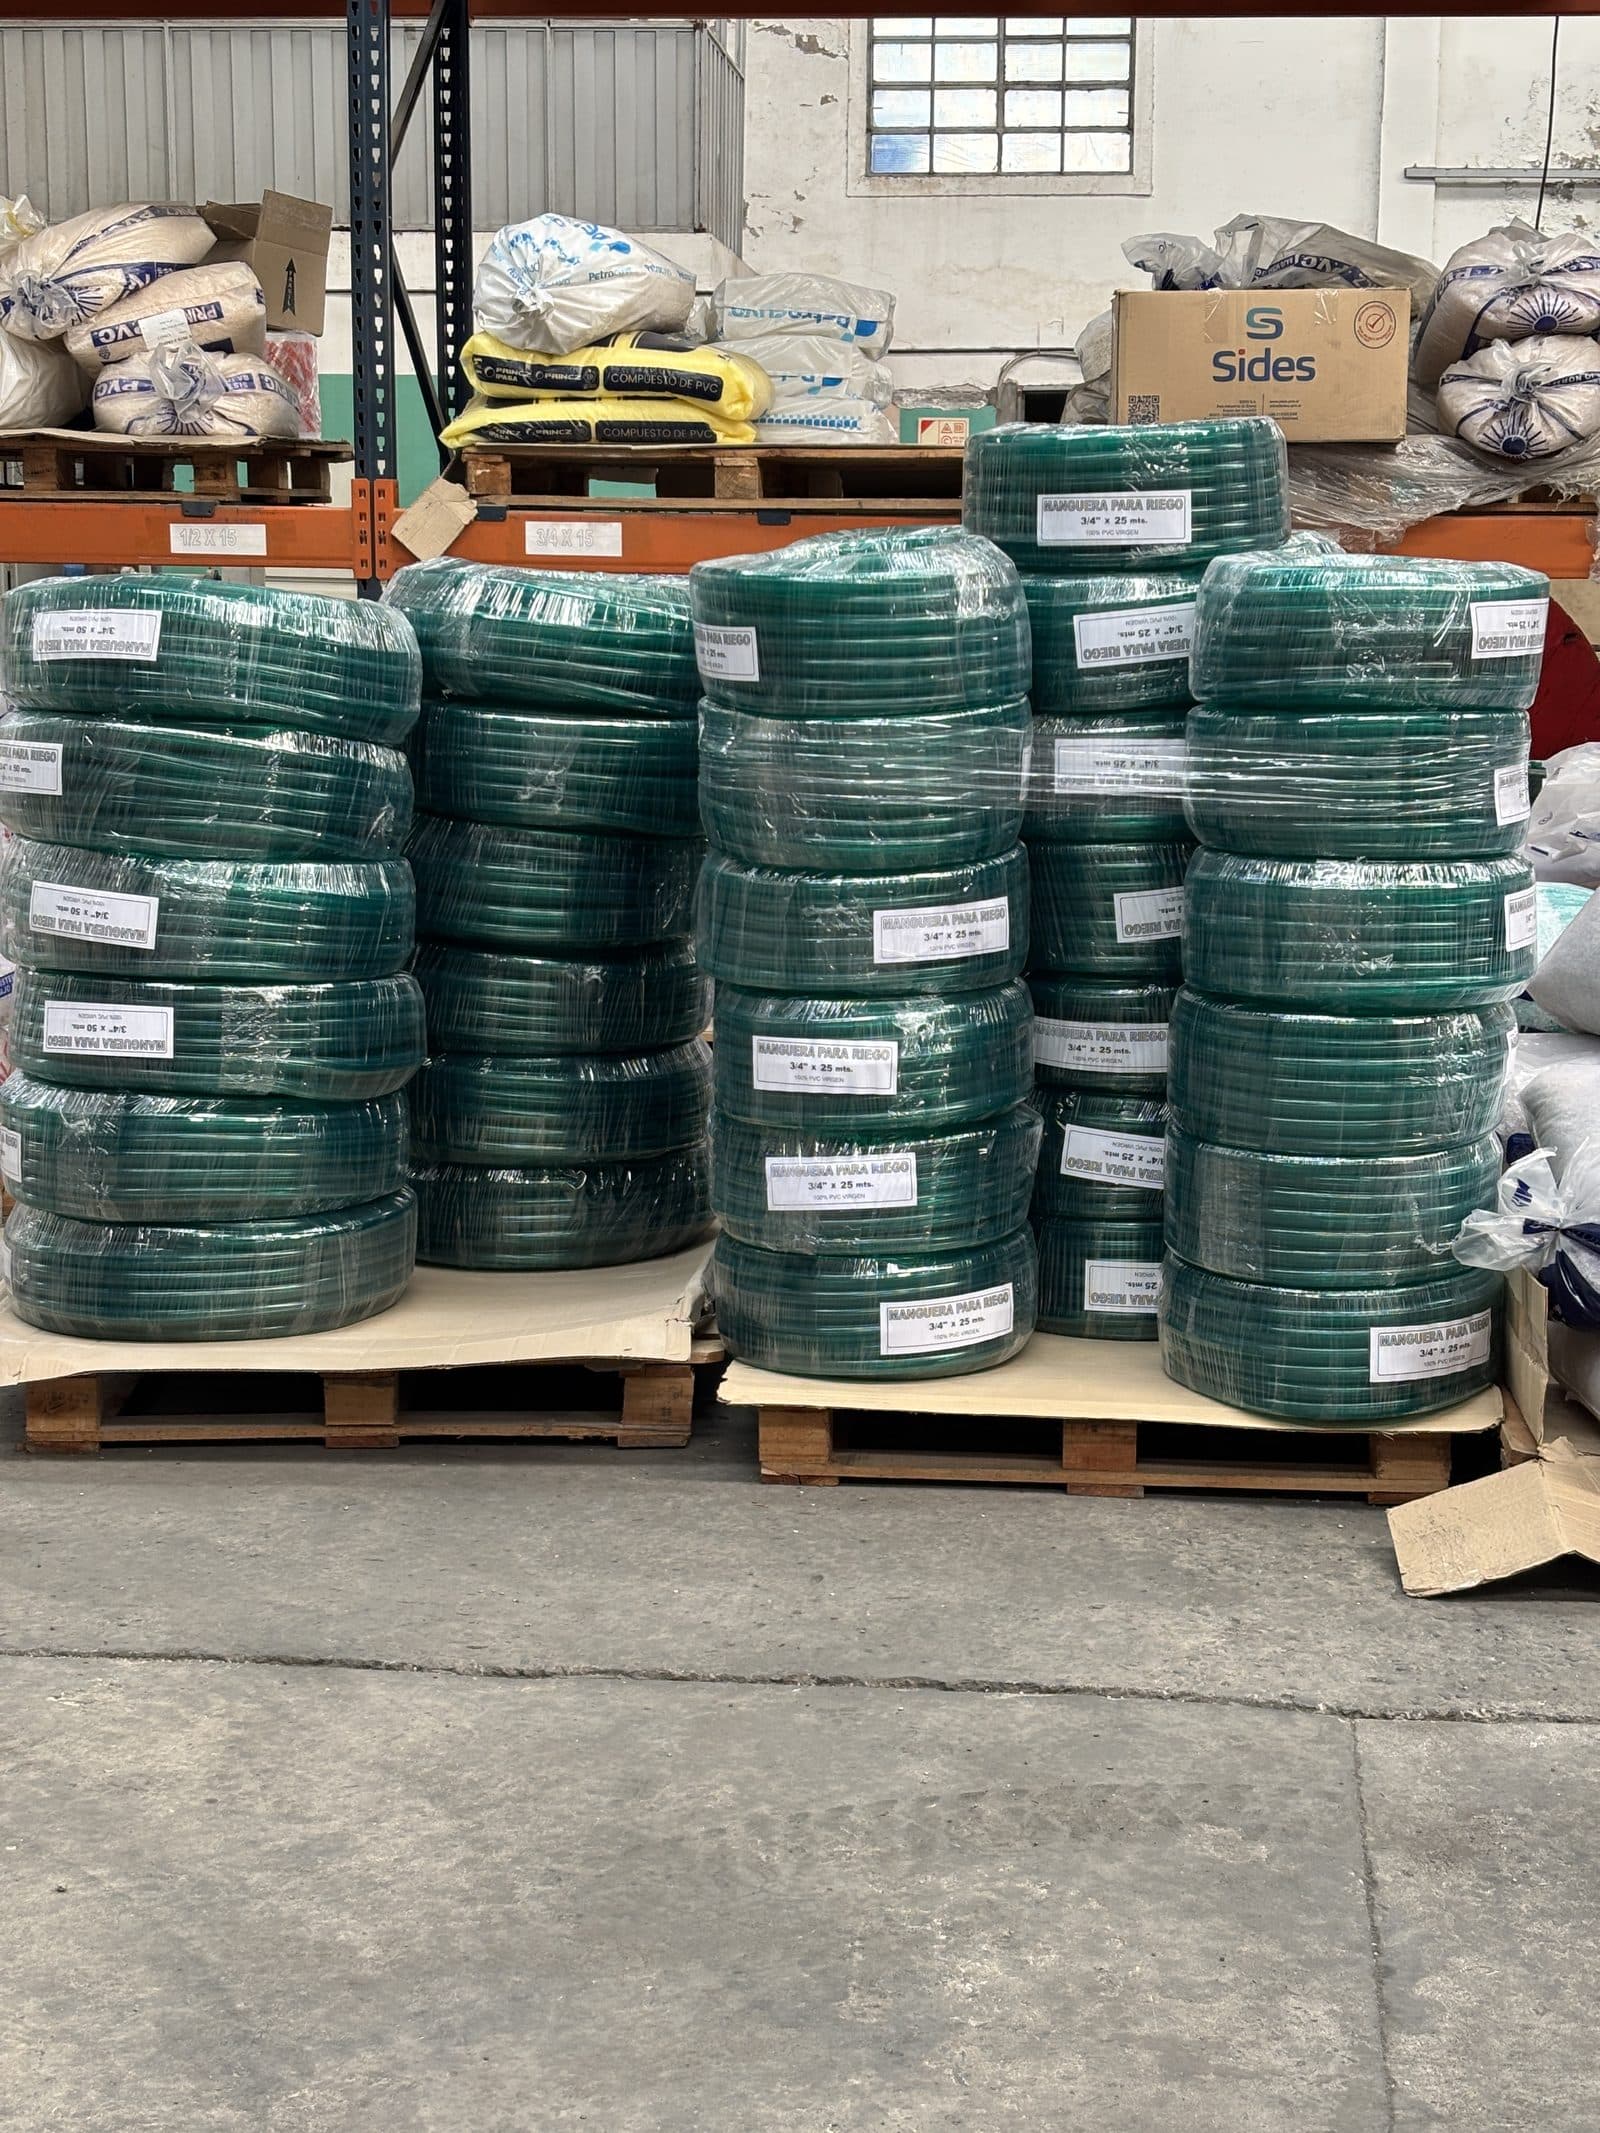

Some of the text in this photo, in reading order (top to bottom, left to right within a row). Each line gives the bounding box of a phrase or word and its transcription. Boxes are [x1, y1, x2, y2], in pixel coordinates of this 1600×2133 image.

[1212, 347, 1316, 382] Sides
[544, 372, 582, 381] PRINCZ
[611, 372, 719, 393] COMPUESTO DE PVC
[603, 427, 713, 439] COMPUESTO DE PVC
[1043, 498, 1184, 512] MANGUERA PARA RIEGO
[1080, 517, 1101, 526] 3/4"
[1114, 516, 1127, 525] 25
[1129, 517, 1148, 525] mts.
[180, 528, 202, 547] 1/2
[220, 528, 237, 547] 15
[576, 529, 593, 547] 15
[76, 626, 86, 634] 50
[97, 626, 115, 635] 3/4"
[1138, 629, 1151, 638] 25
[1164, 625, 1183, 635] 3/4"
[63, 639, 87, 652] PARA
[723, 634, 751, 646] RIEGO
[1479, 636, 1508, 649] RIEGO
[90, 640, 152, 653] MANGUERA
[1083, 641, 1155, 660] PARA RIEGO
[31, 750, 57, 763] RIEGO
[1113, 760, 1126, 768] 25
[1140, 760, 1160, 768] 3/4"
[70, 907, 80, 915] 50
[90, 910, 109, 920] 3/4"
[882, 908, 1006, 929] MANGUERA PARA RIEGO
[32, 914, 147, 941] MANGUERA PARA RIEGO
[1124, 921, 1161, 935] RIEGO
[924, 932, 943, 942] 3/4"
[955, 930, 967, 939] 25
[87, 1024, 97, 1032] 50
[108, 1025, 127, 1033] 3/4"
[1034, 1023, 1166, 1042] MANGUERA PARA RIEGO
[47, 1035, 165, 1051] MANGUERA PARA RIEGO
[1067, 1044, 1086, 1052] 3/4"
[1099, 1046, 1111, 1054] 25
[758, 1042, 890, 1061] MANGUERA PARA RIEGO
[790, 1061, 808, 1071] 3/4"
[820, 1063, 833, 1072] 25
[834, 1065, 853, 1073] mts.
[1103, 1150, 1120, 1158] mts.
[1121, 1153, 1134, 1161] 25
[770, 1161, 910, 1178] MANGUERA PARA RIEGO
[1067, 1157, 1136, 1177] PARA RIEGO
[808, 1181, 827, 1190] 3/4"
[840, 1181, 853, 1189] 25
[1145, 1281, 1158, 1290] 25
[1091, 1292, 1127, 1304] RIEGO
[888, 1291, 1009, 1321] MANGUERA PARA RIEGO
[928, 1321, 948, 1331] 3/4"
[959, 1317, 970, 1326] 25
[1379, 1316, 1490, 1346] MANGUERA PARA RIEGO
[1419, 1348, 1438, 1357] 3/4"
[1448, 1344, 1458, 1353] 25
